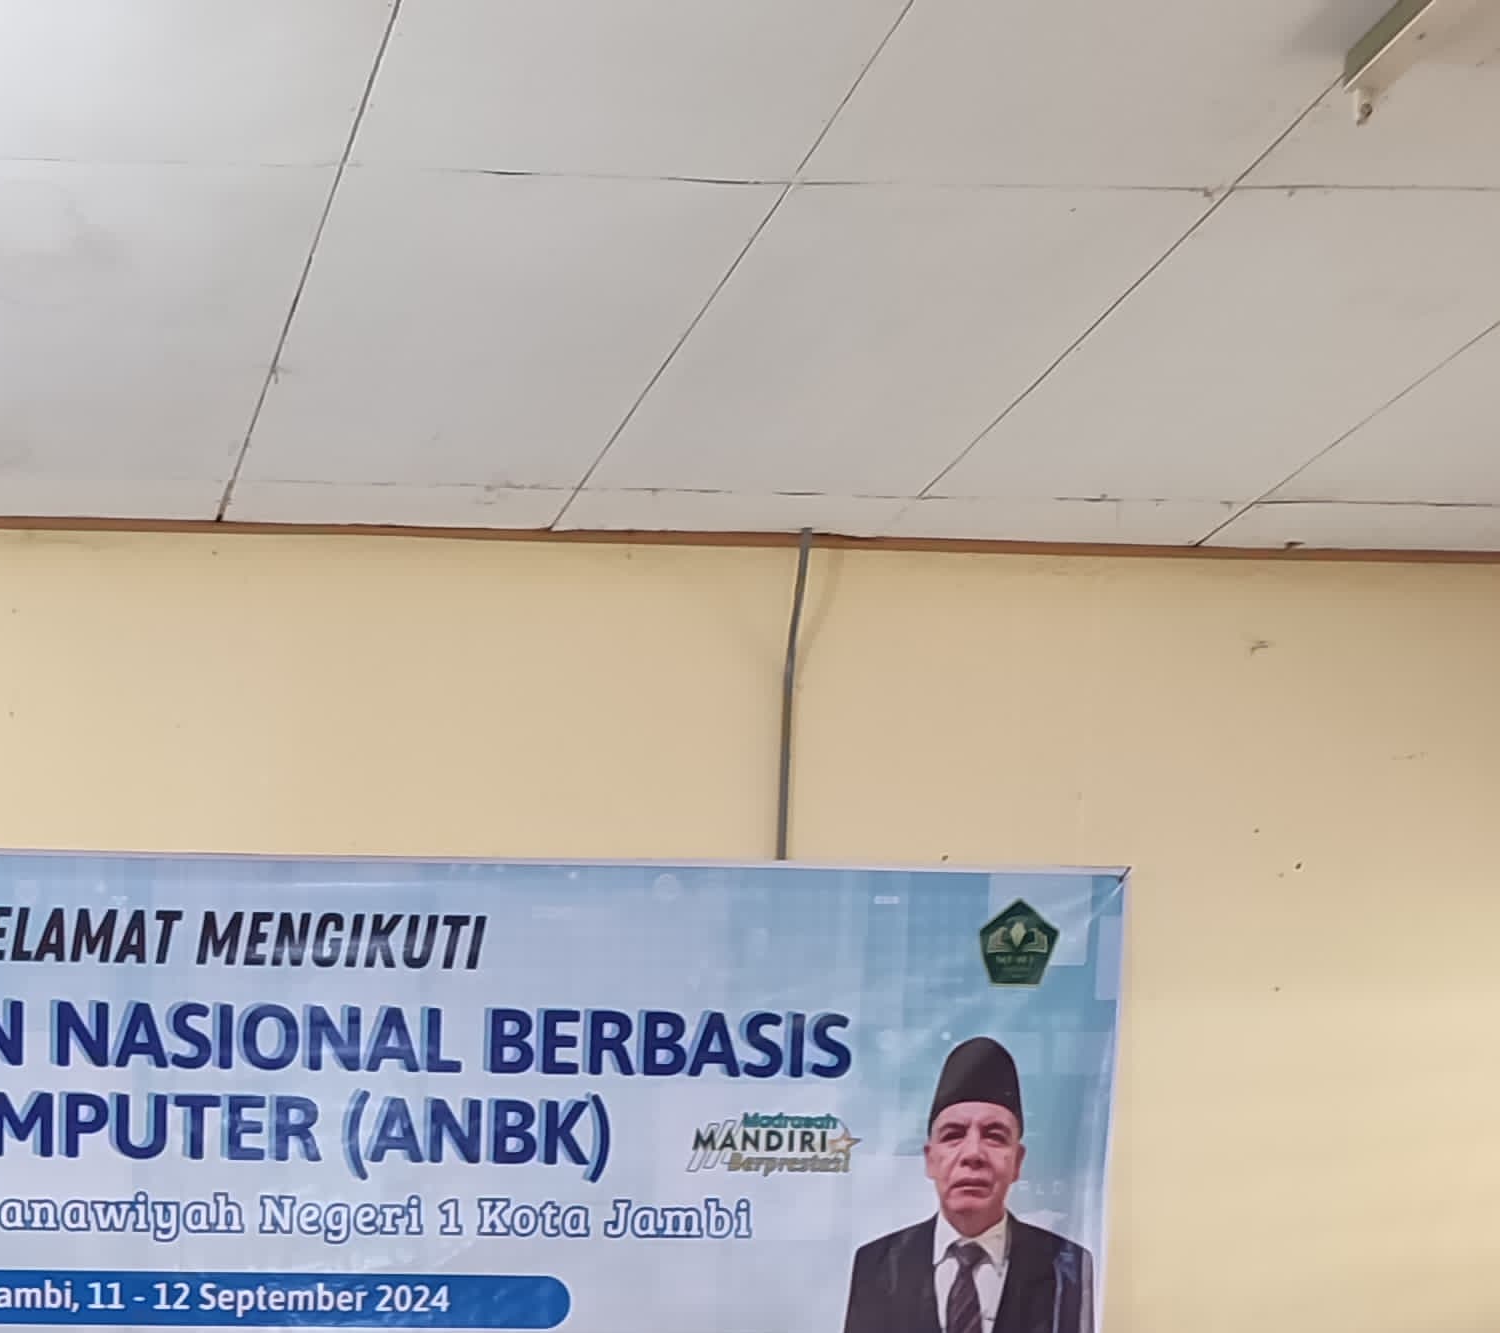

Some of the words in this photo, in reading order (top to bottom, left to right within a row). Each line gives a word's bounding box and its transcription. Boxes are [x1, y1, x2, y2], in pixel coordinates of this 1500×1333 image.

[196, 910, 488, 970] MENGIKUTI
[50, 999, 462, 1073] NASIONAL
[483, 1006, 853, 1079] BERBASIS
[341, 1089, 611, 1184] (ANBK)
[691, 1128, 828, 1153] MANDIRI
[741, 1112, 838, 1130] Madrasah
[727, 1152, 851, 1177] Berprestasi
[258, 1195, 425, 1245] Negeri
[438, 1199, 463, 1237] 1
[476, 1199, 591, 1238] Kota
[603, 1198, 753, 1240] Jambi
[87, 1283, 125, 1311] 11
[152, 1284, 191, 1312] 12
[198, 1284, 369, 1319] September
[374, 1286, 451, 1313] 2024
